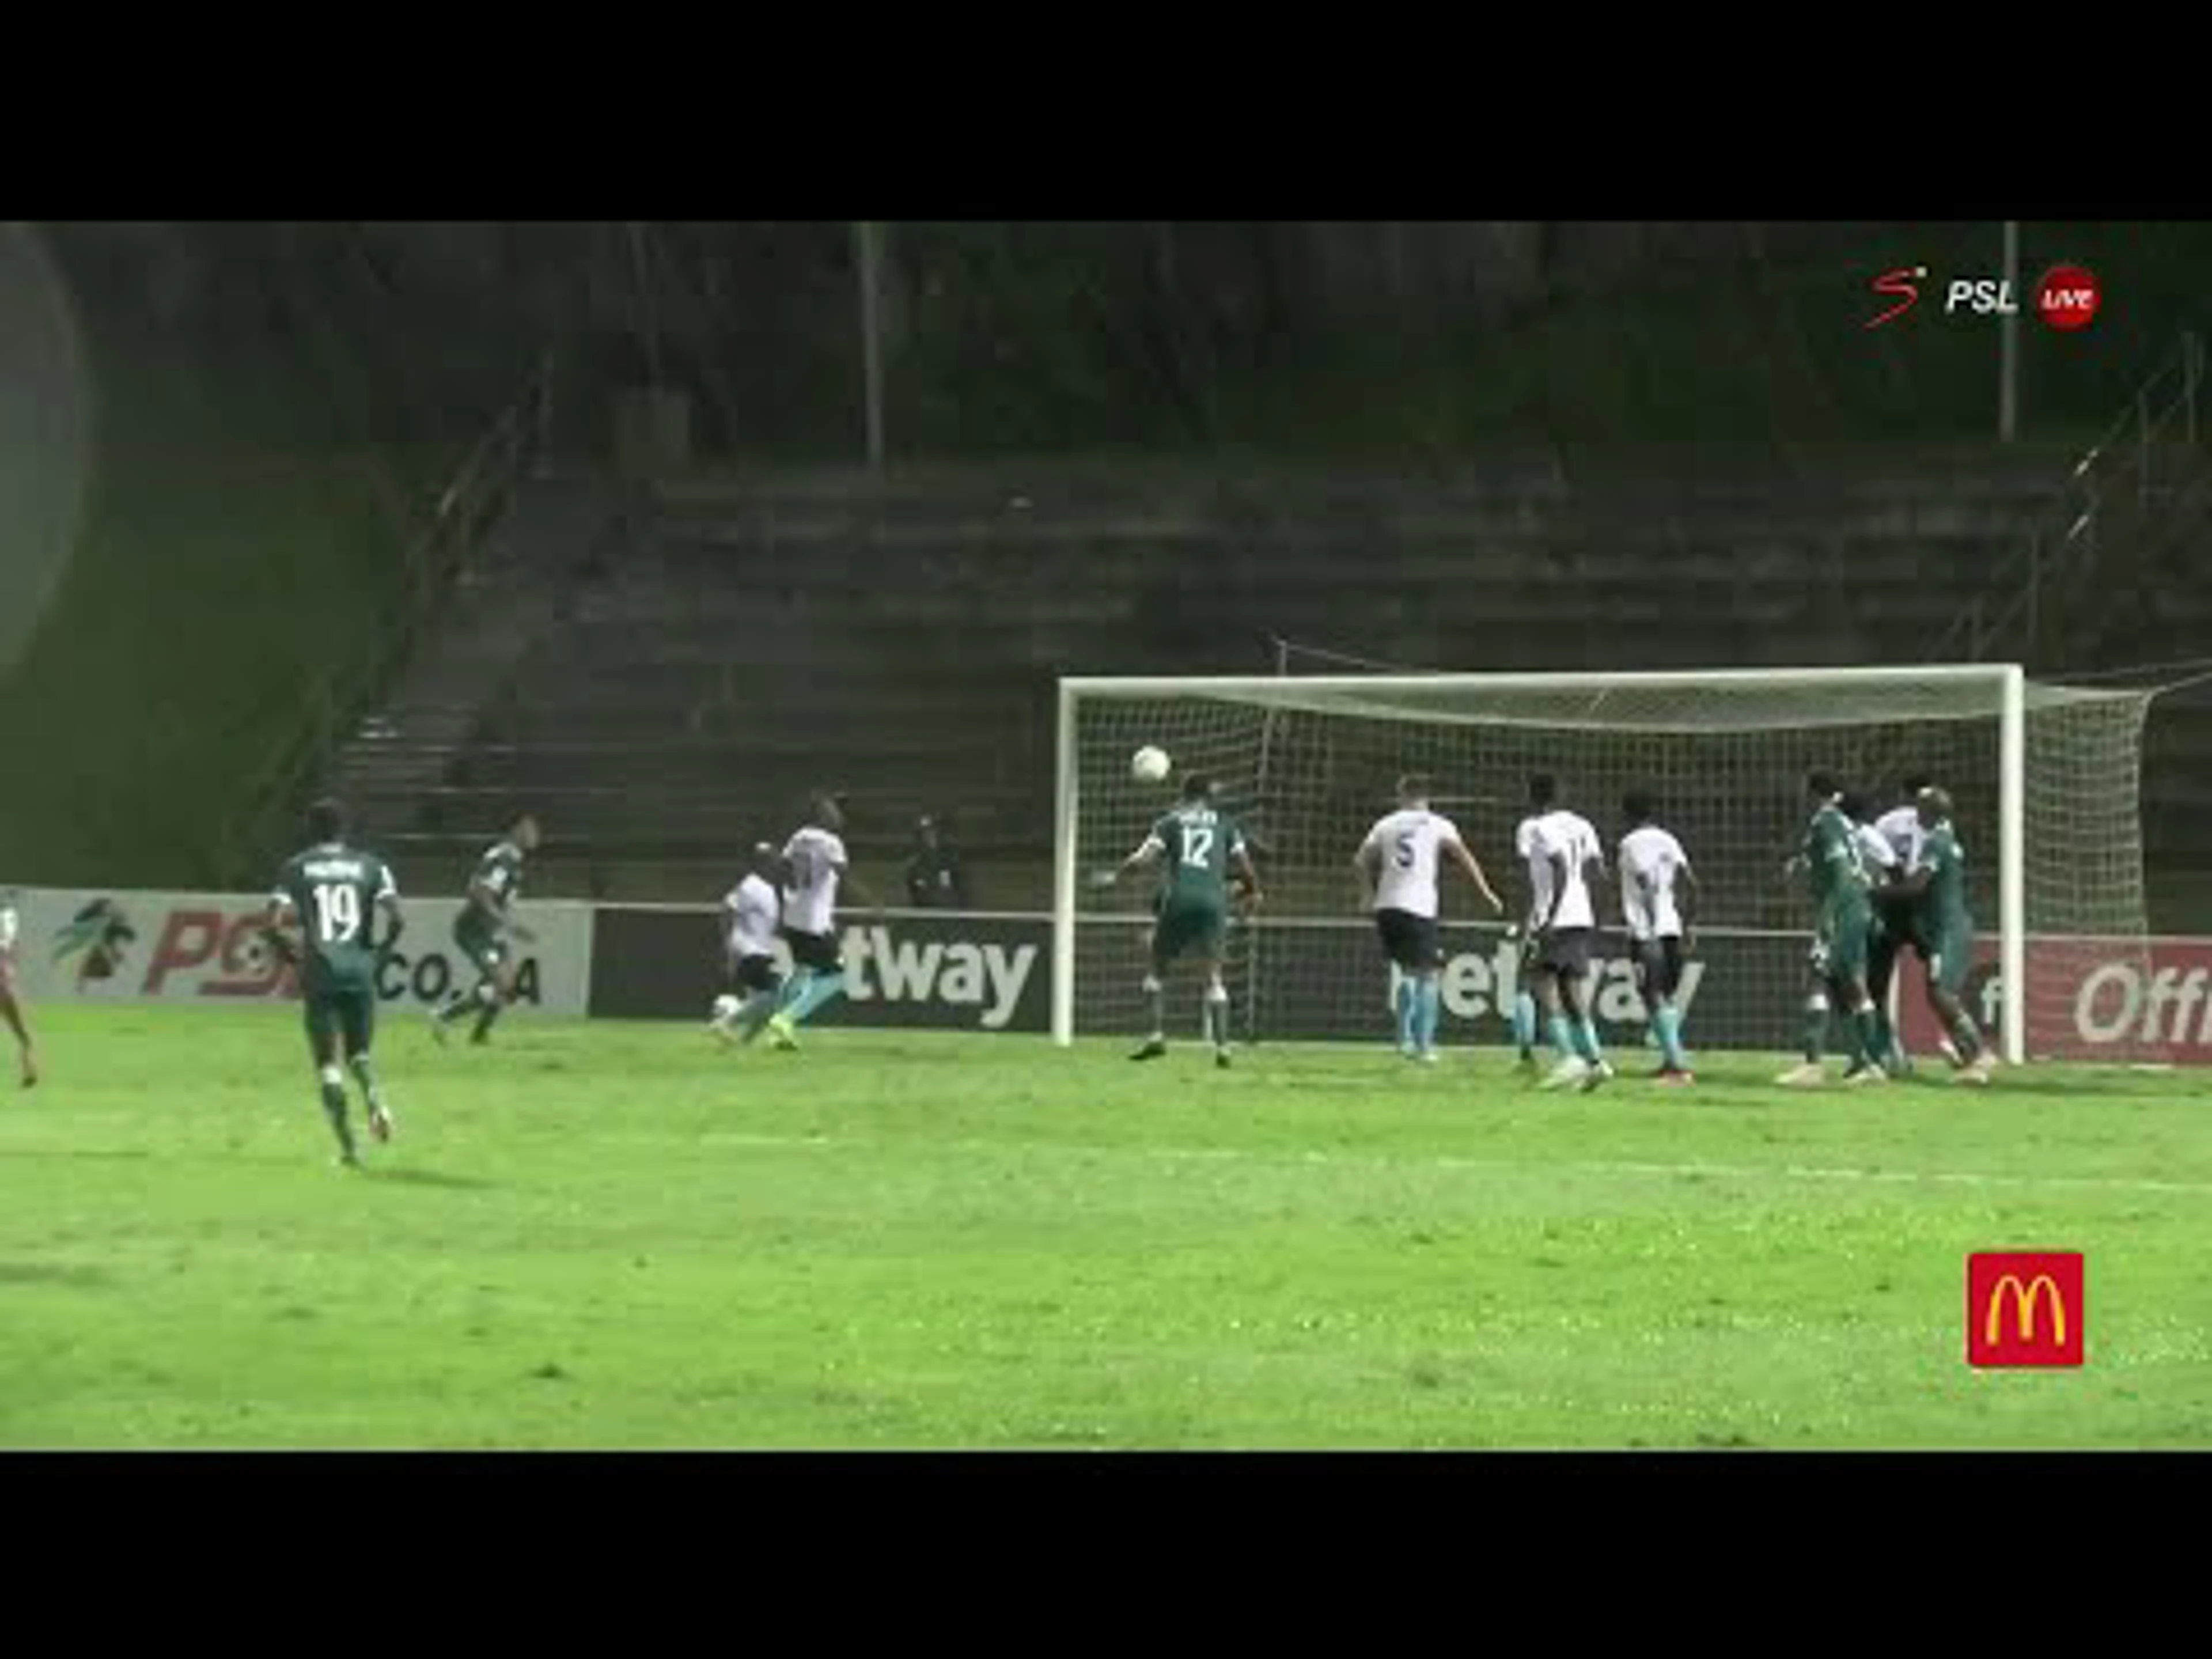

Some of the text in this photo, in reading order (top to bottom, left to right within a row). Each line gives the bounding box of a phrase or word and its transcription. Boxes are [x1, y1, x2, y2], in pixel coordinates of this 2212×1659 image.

[1180, 827, 1214, 868] 12
[1396, 829, 1416, 868] 5
[313, 883, 361, 941] 19
[140, 911, 305, 996] PS
